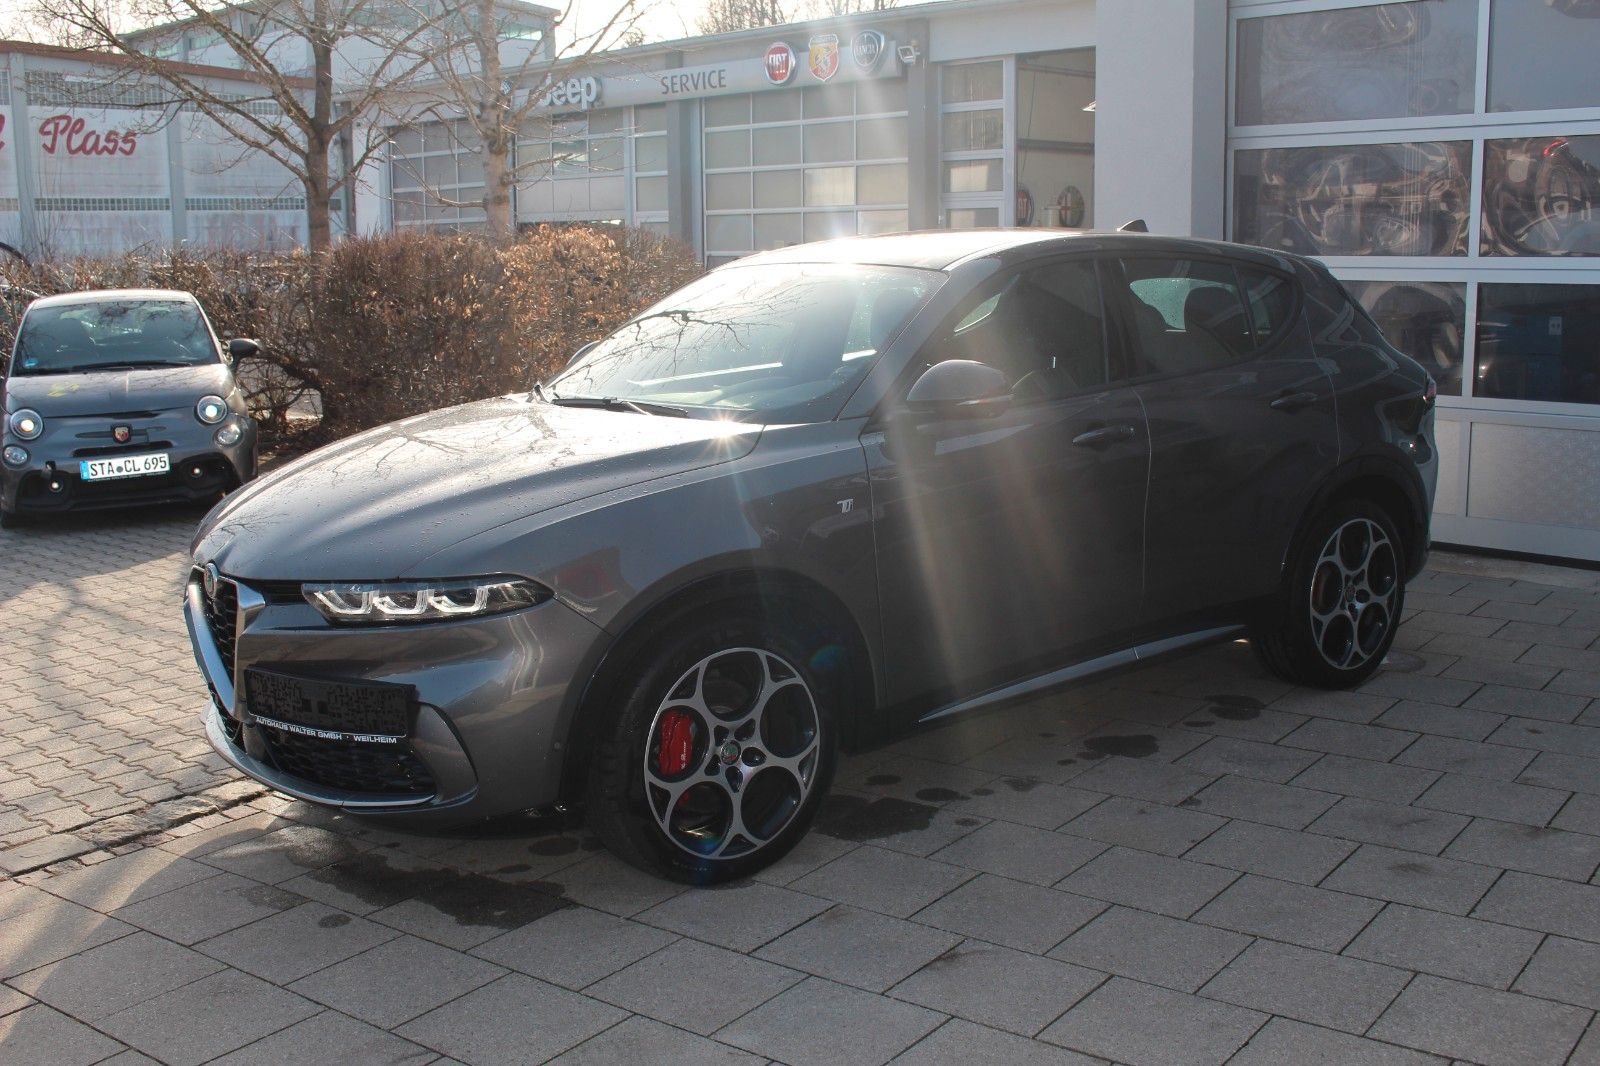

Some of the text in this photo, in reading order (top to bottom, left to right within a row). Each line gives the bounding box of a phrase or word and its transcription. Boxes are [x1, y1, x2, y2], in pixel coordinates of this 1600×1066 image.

[537, 73, 597, 110] Jeep
[660, 69, 727, 95] SERVICE
[39, 114, 137, 156] Plass
[90, 461, 115, 477] STA
[124, 459, 140, 473] CL
[143, 455, 167, 471] 695
[256, 716, 288, 731] AUTOHAUS
[289, 725, 316, 737] WALTER
[353, 735, 397, 744] WEILHEIM
